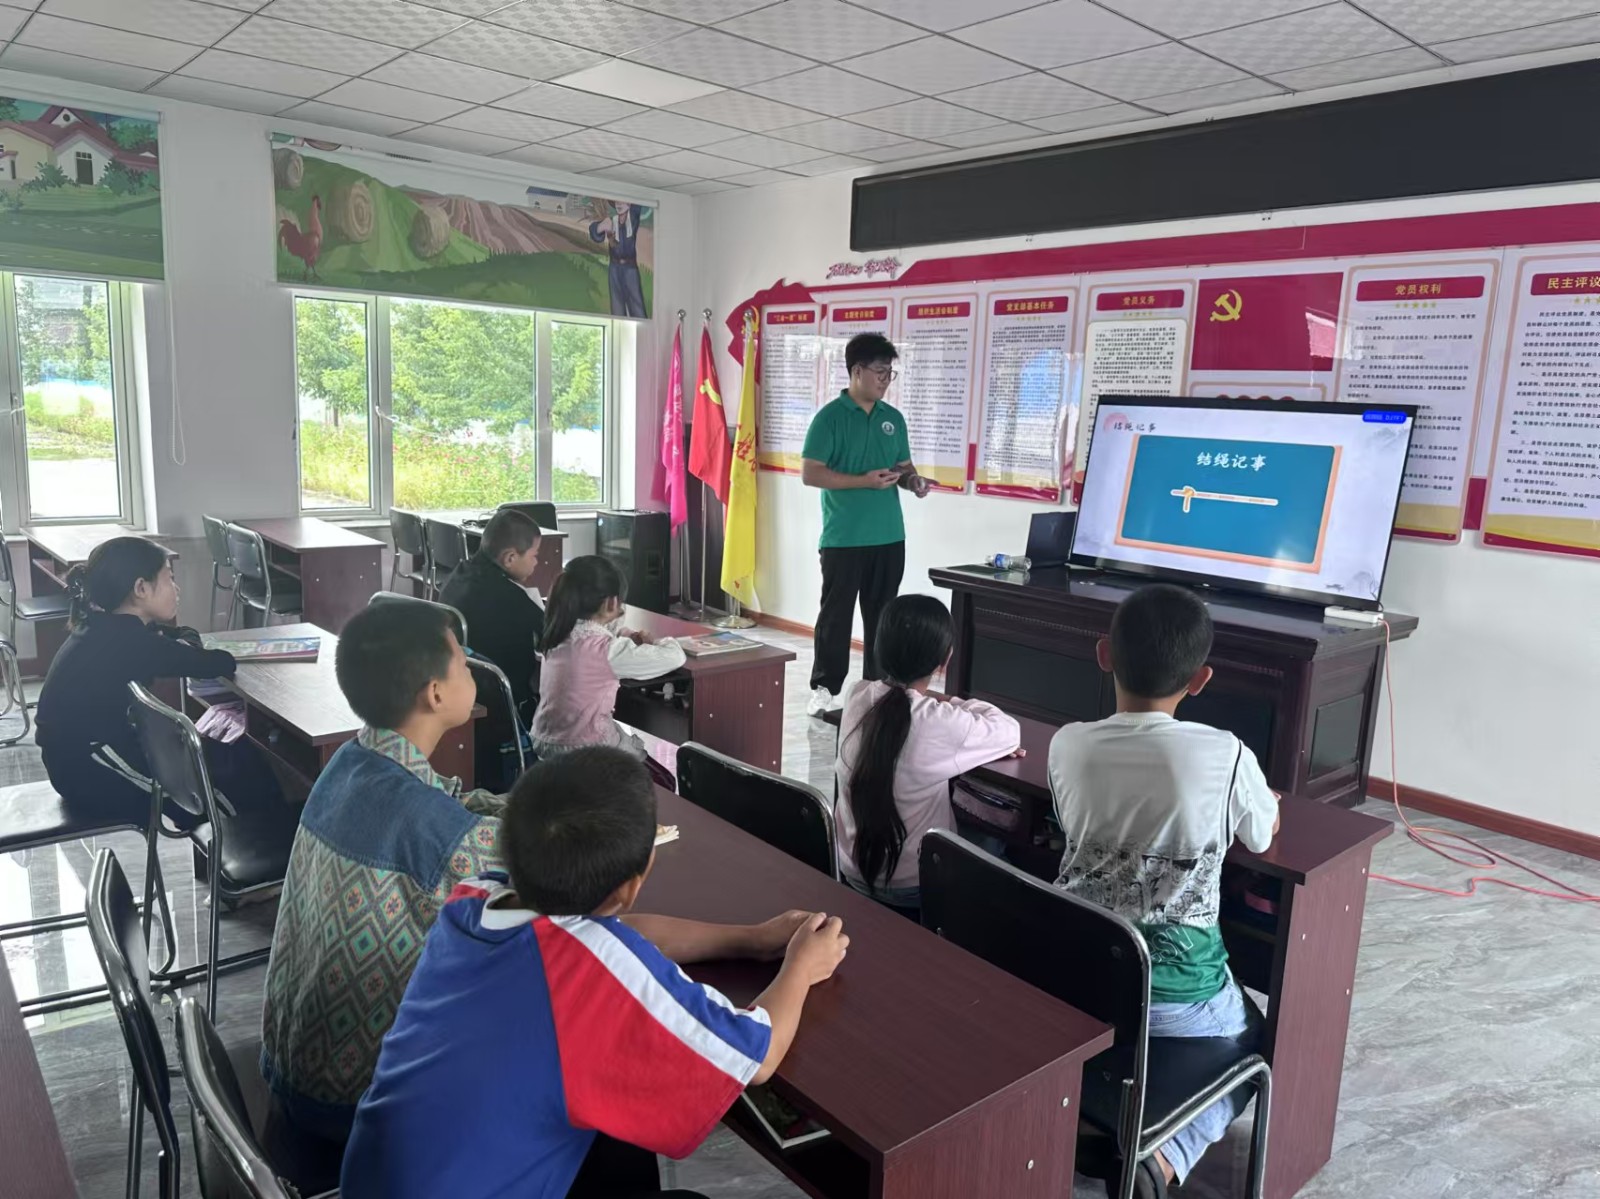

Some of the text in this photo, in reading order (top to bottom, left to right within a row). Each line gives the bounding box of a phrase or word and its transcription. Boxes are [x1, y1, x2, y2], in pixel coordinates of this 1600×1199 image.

[1547, 276, 1600, 289] 民主评议
[1395, 283, 1441, 295] 党员权利
[1006, 301, 1054, 311] 党支部基本任务
[1122, 296, 1155, 305] 党员义务
[1113, 422, 1157, 432] 结绳记事
[1196, 451, 1267, 471] 结绳记事
